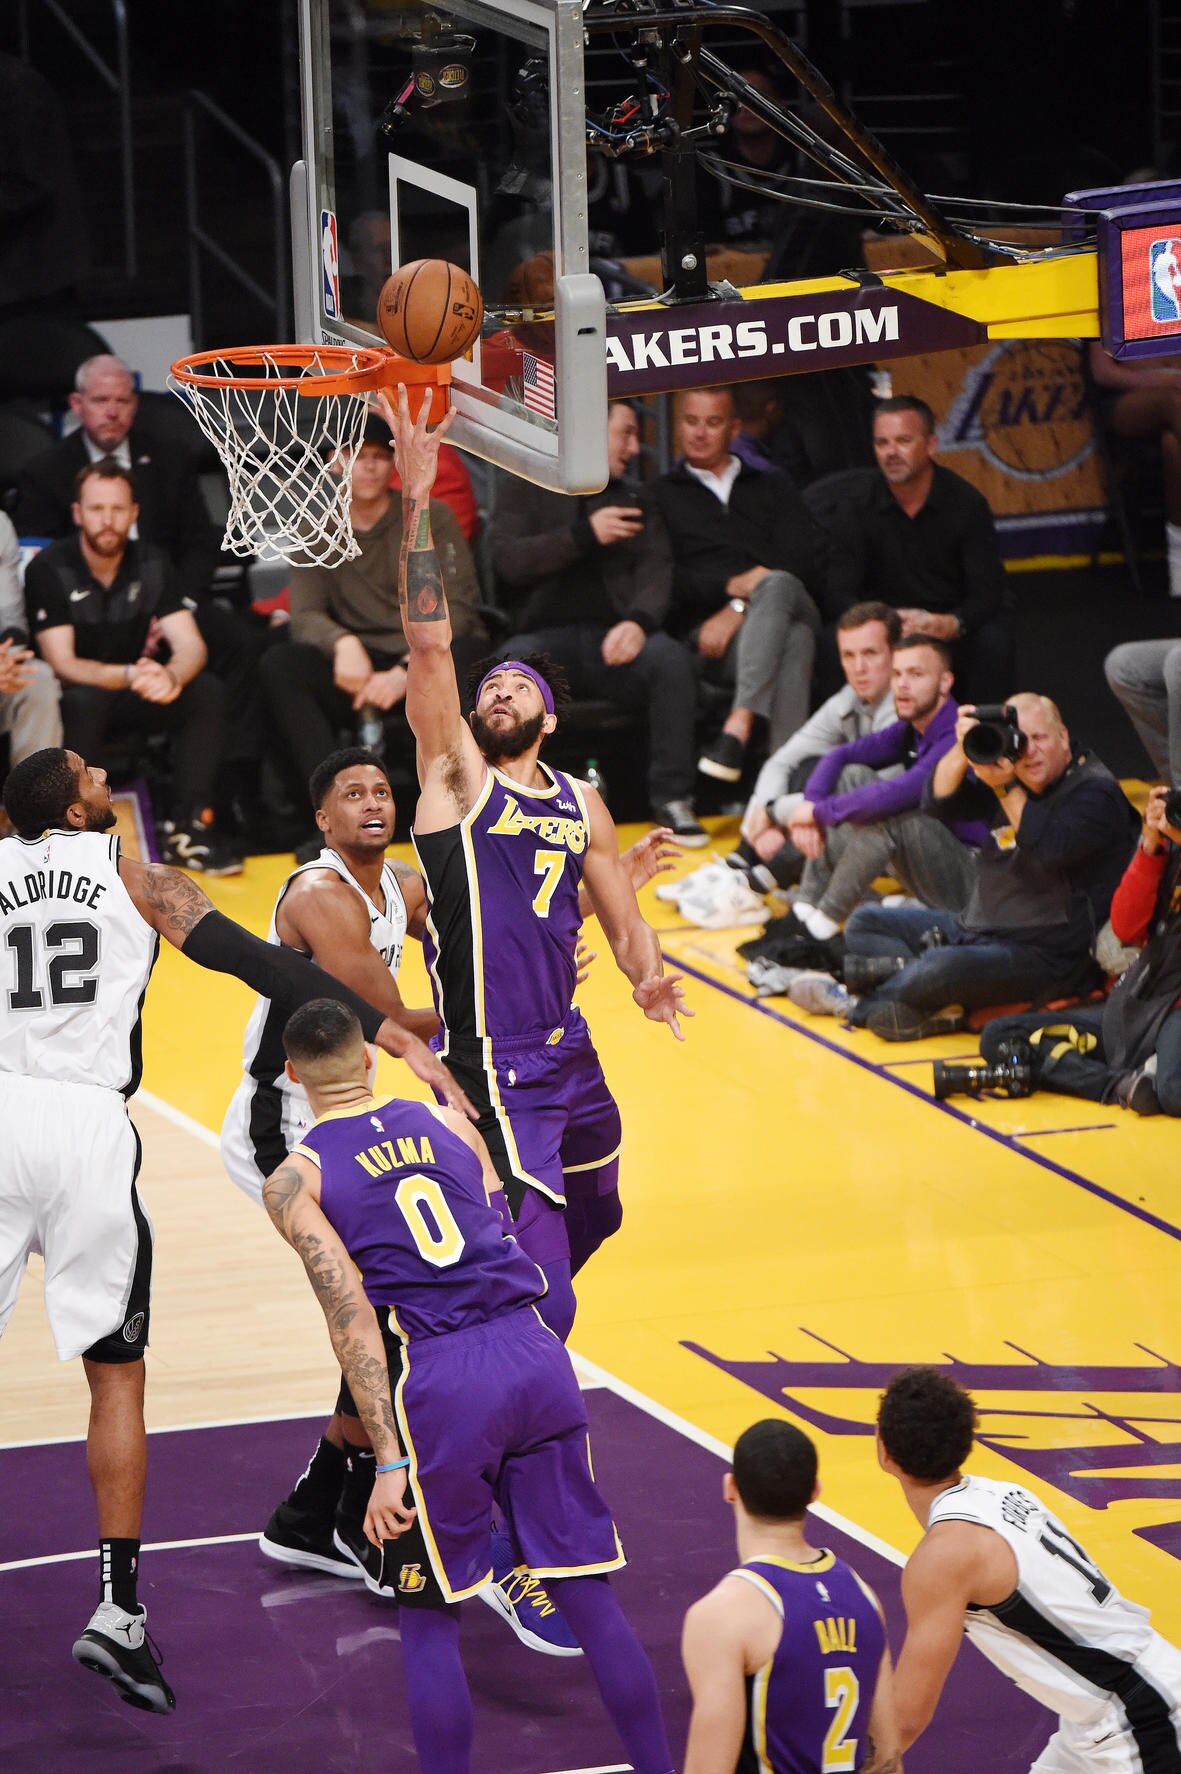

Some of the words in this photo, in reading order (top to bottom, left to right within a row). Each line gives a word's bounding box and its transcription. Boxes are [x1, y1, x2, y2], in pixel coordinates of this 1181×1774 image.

[0, 870, 107, 916] ALDRIDGE
[532, 849, 567, 918] 7
[3, 918, 102, 1013] 12
[354, 1136, 437, 1178] KUZMA
[394, 1173, 466, 1268] 0
[813, 1616, 858, 1655] BALL
[821, 1666, 861, 1774] 2
